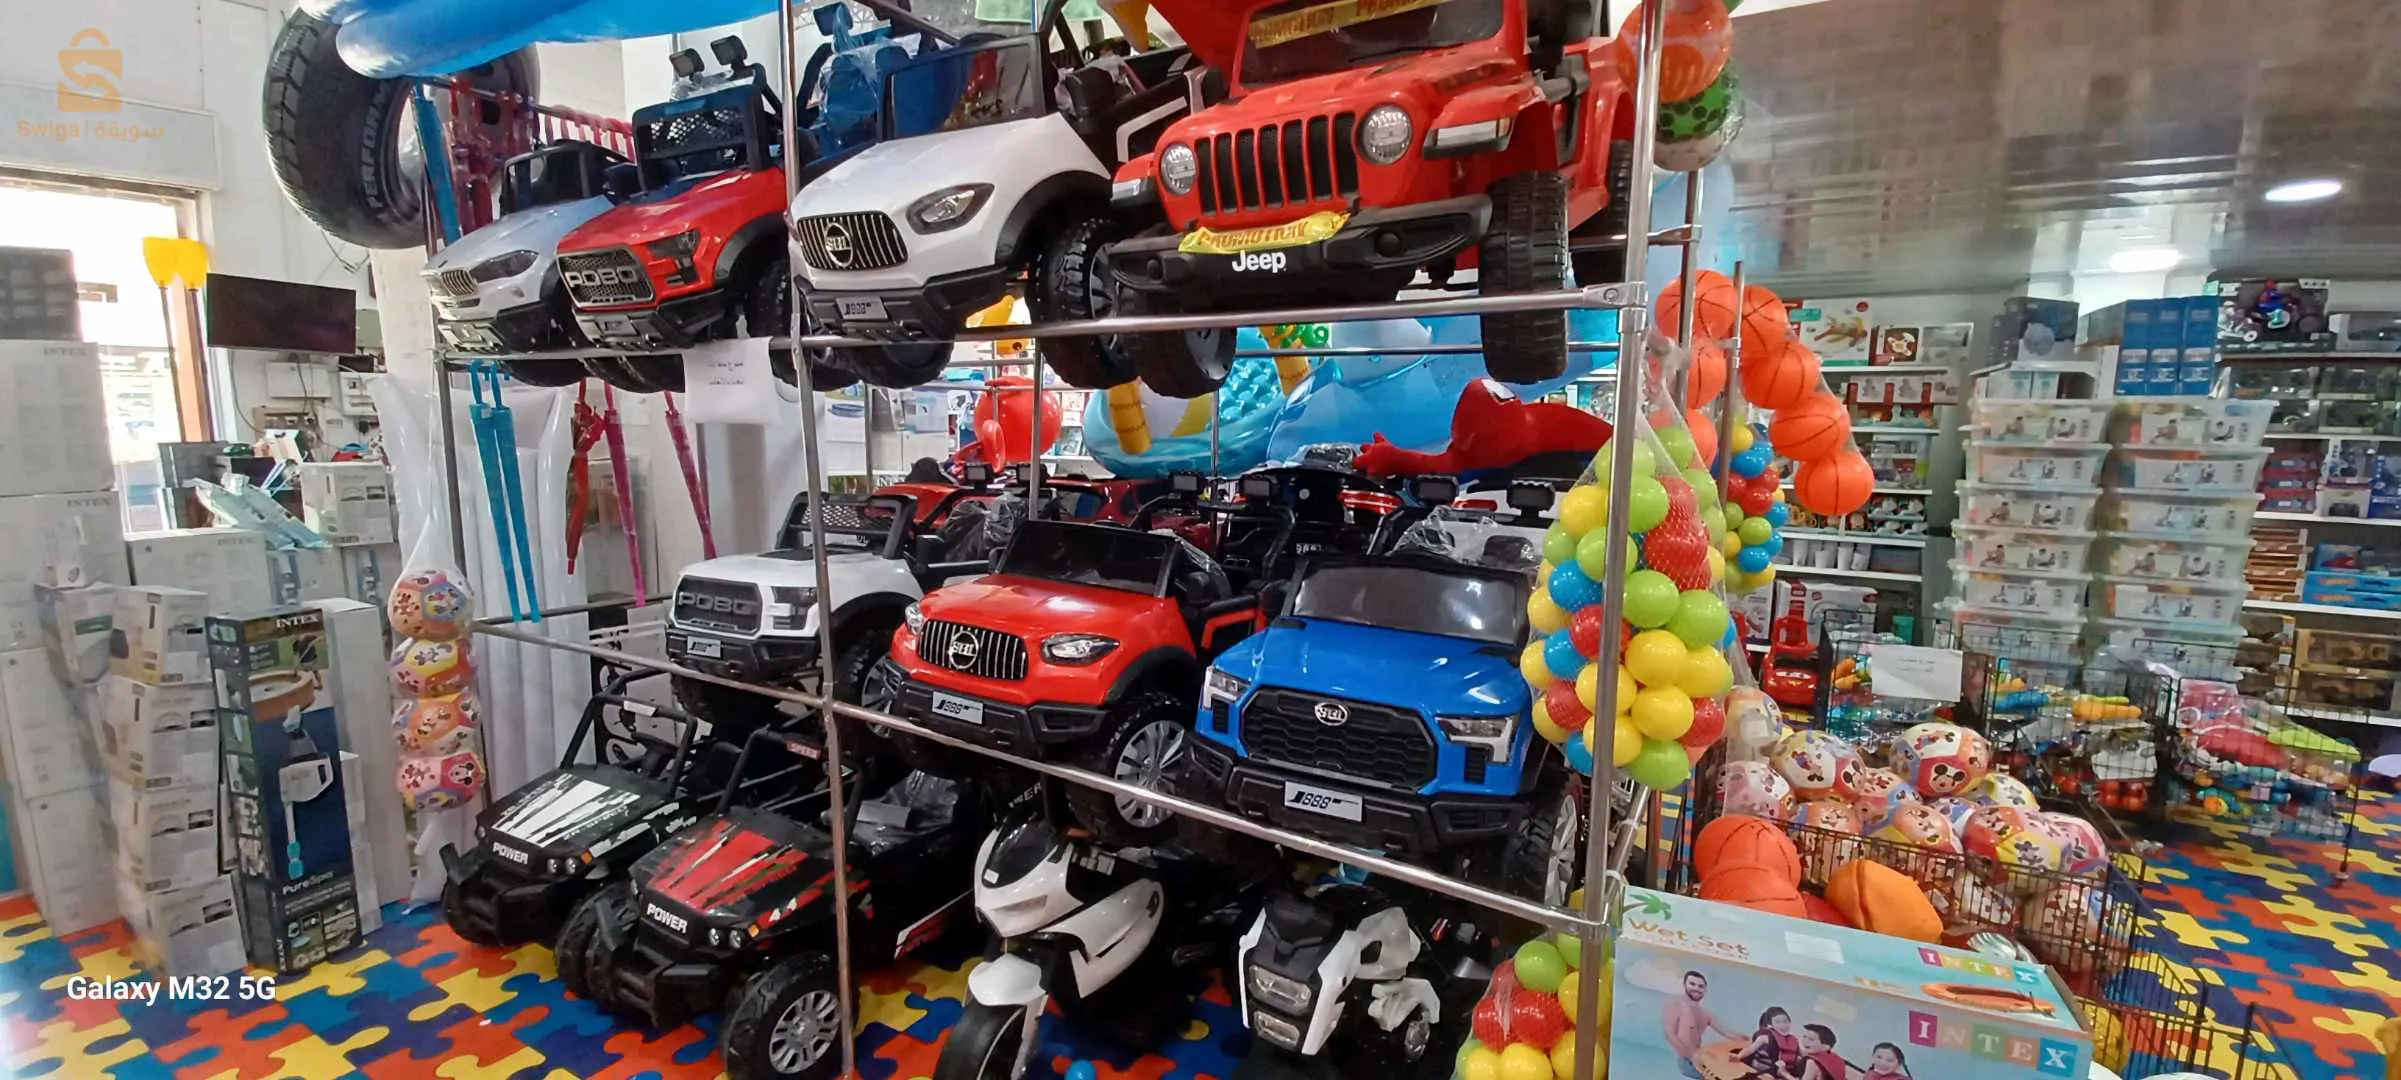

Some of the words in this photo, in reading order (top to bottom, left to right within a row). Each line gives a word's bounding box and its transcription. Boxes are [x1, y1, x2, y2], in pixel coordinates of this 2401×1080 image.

[1232, 250, 1286, 273] Jeep
[276, 615, 319, 628] INTEX
[492, 842, 529, 864] POWER
[646, 903, 689, 933] POWER
[1628, 917, 1689, 942] Wet
[1697, 934, 1749, 957] Set
[1923, 950, 2037, 983] INTEX
[1918, 1018, 2068, 1070] INTEX
